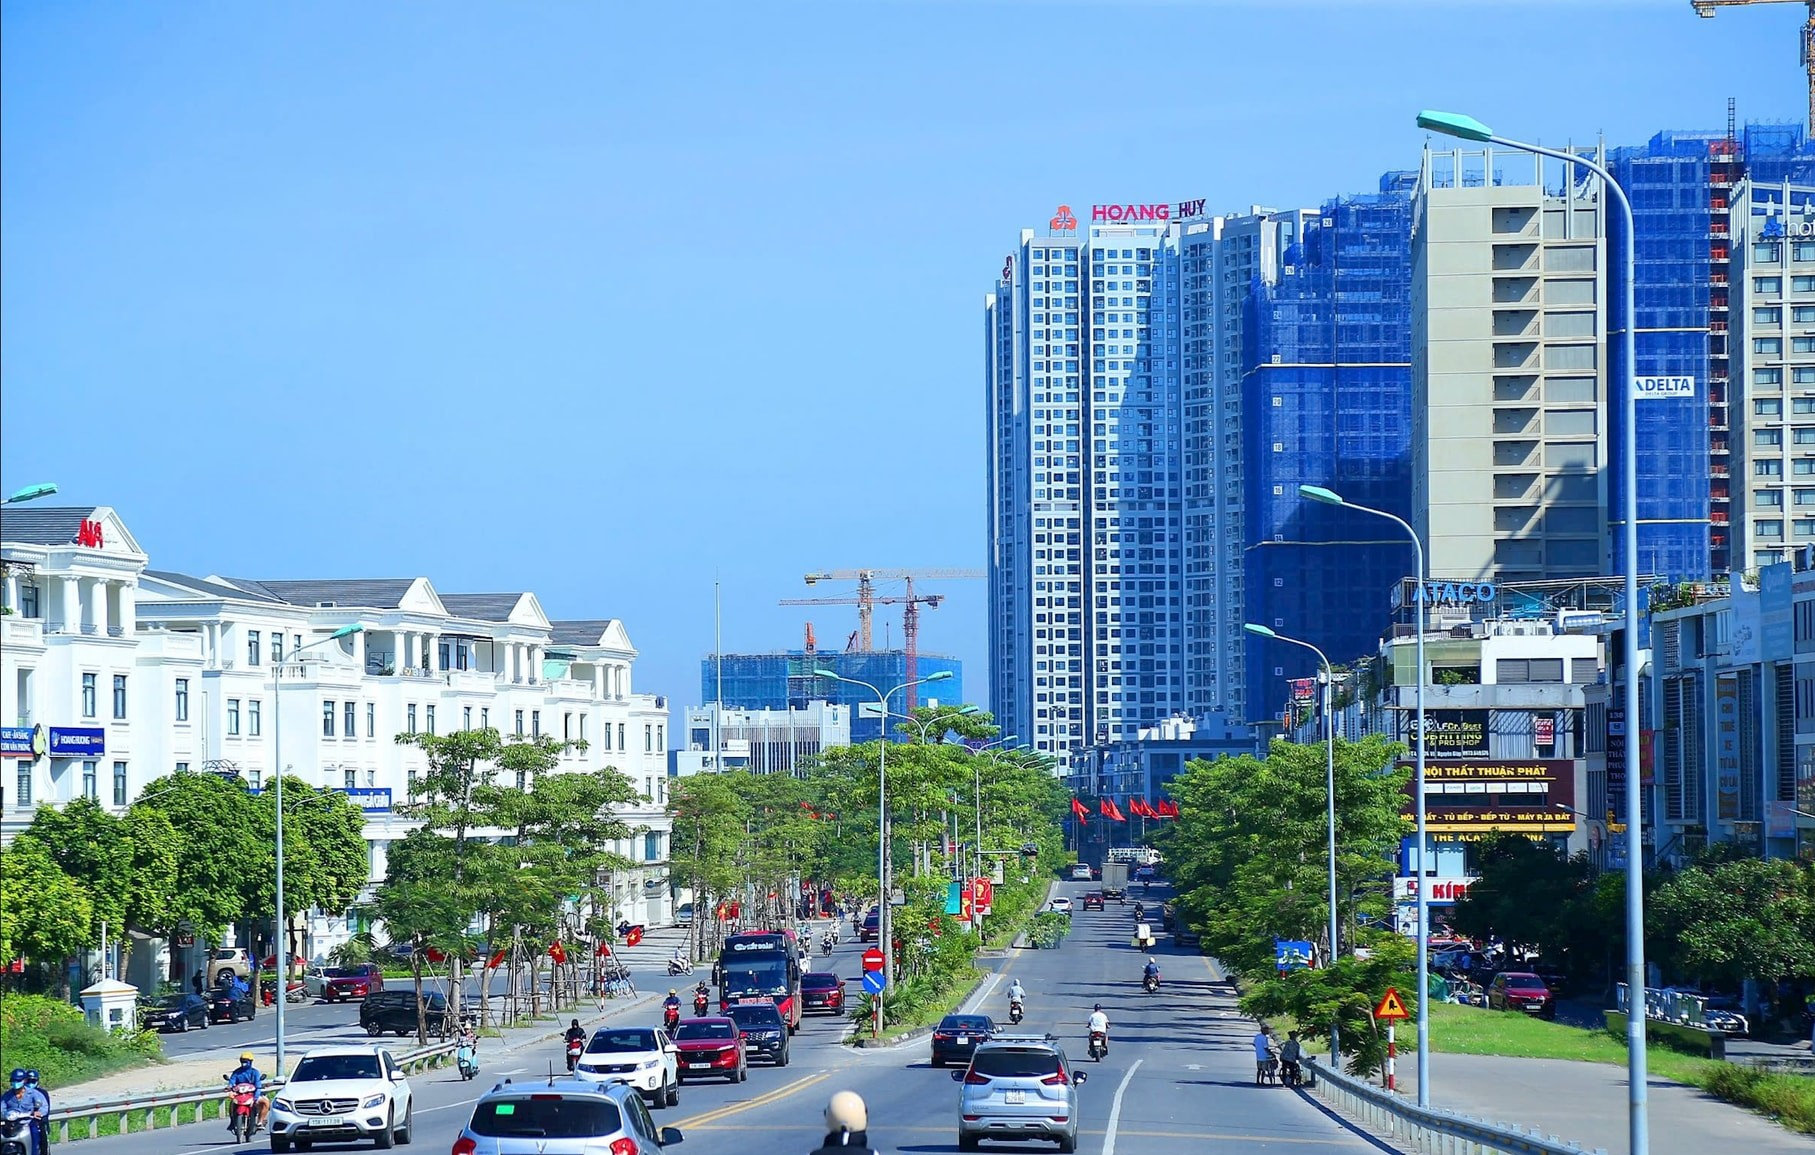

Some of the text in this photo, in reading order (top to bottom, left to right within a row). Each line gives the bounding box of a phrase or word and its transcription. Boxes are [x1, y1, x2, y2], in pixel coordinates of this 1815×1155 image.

[1092, 199, 1206, 220] HOANG HUY
[1645, 378, 1690, 391] DELTA
[1412, 582, 1496, 602] ATACO
[1424, 765, 1442, 778] NỘI
[1445, 764, 1474, 776] THẤT
[1517, 764, 1547, 776] PHÁT
[1517, 812, 1535, 821] MÁY
[1434, 834, 1454, 842] THE
